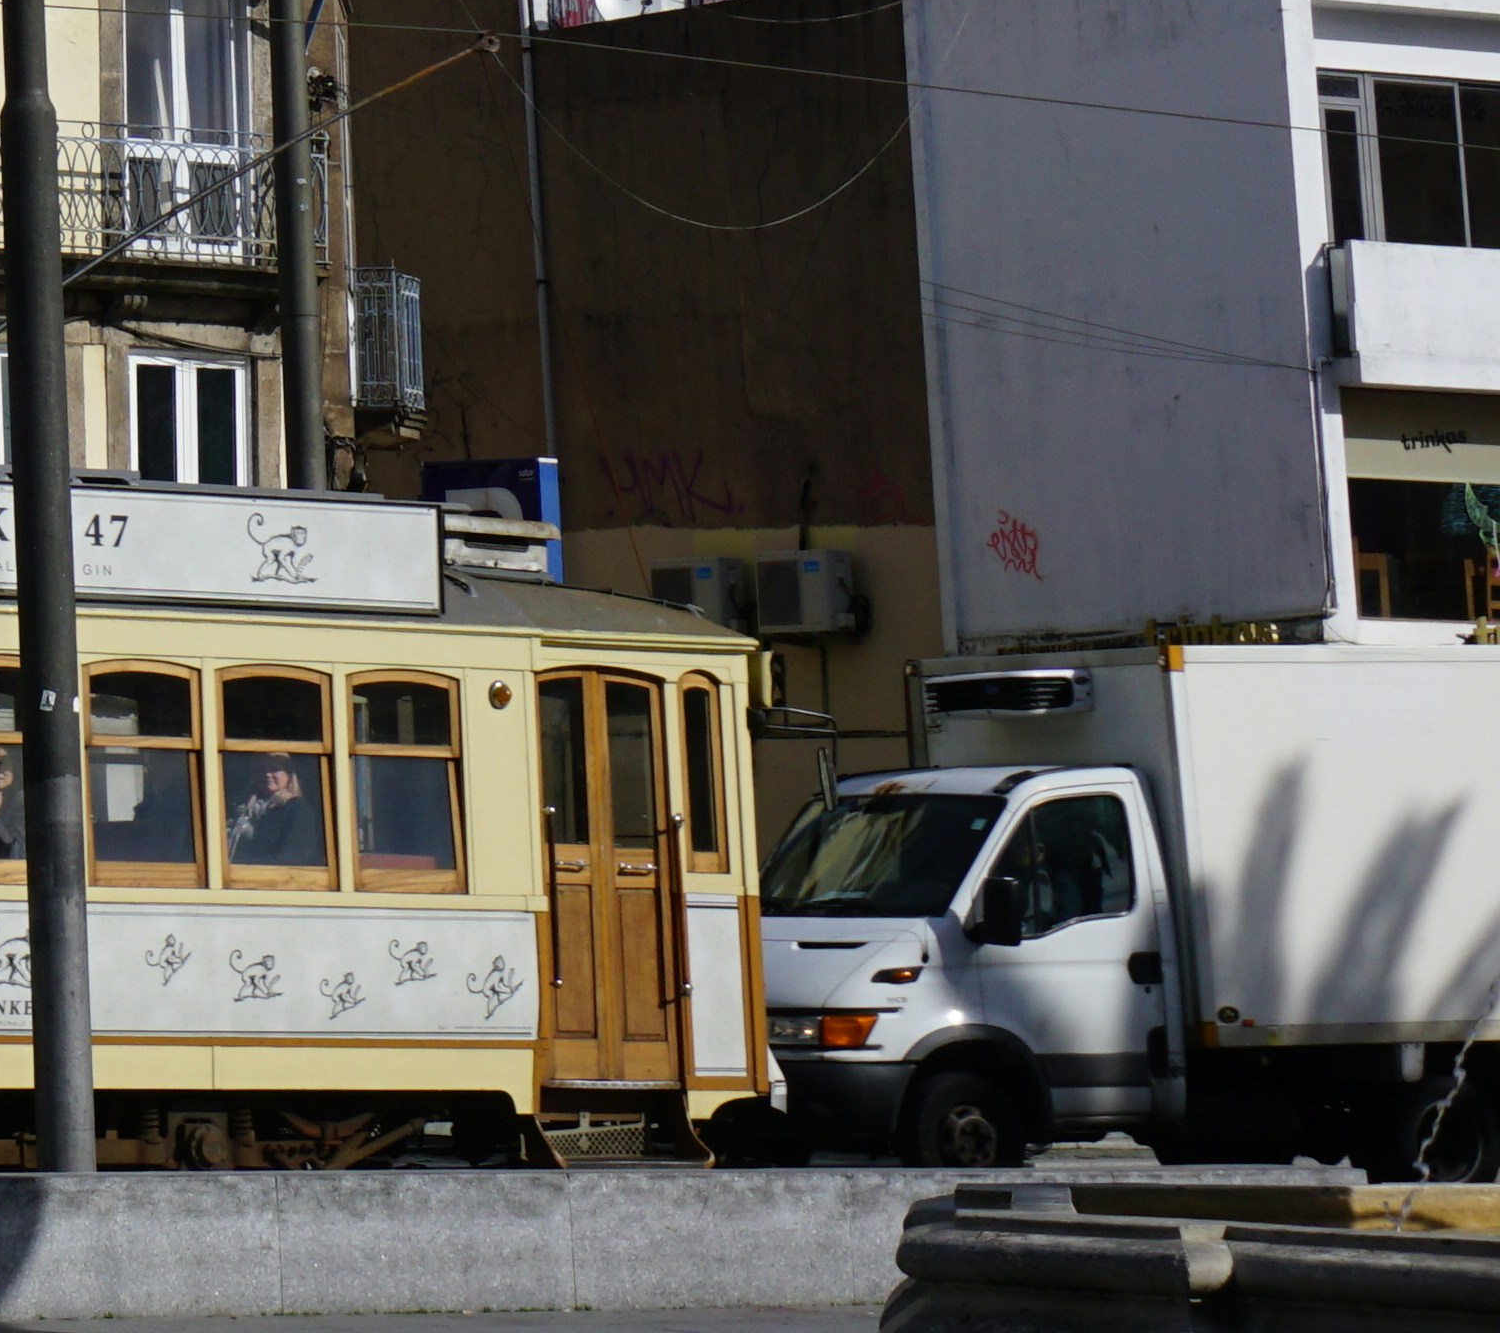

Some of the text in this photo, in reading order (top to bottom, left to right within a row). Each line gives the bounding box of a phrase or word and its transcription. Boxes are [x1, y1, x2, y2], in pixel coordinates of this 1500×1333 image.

[1401, 429, 1467, 453] trinkas
[84, 513, 129, 548] 47
[83, 563, 113, 577] GIN
